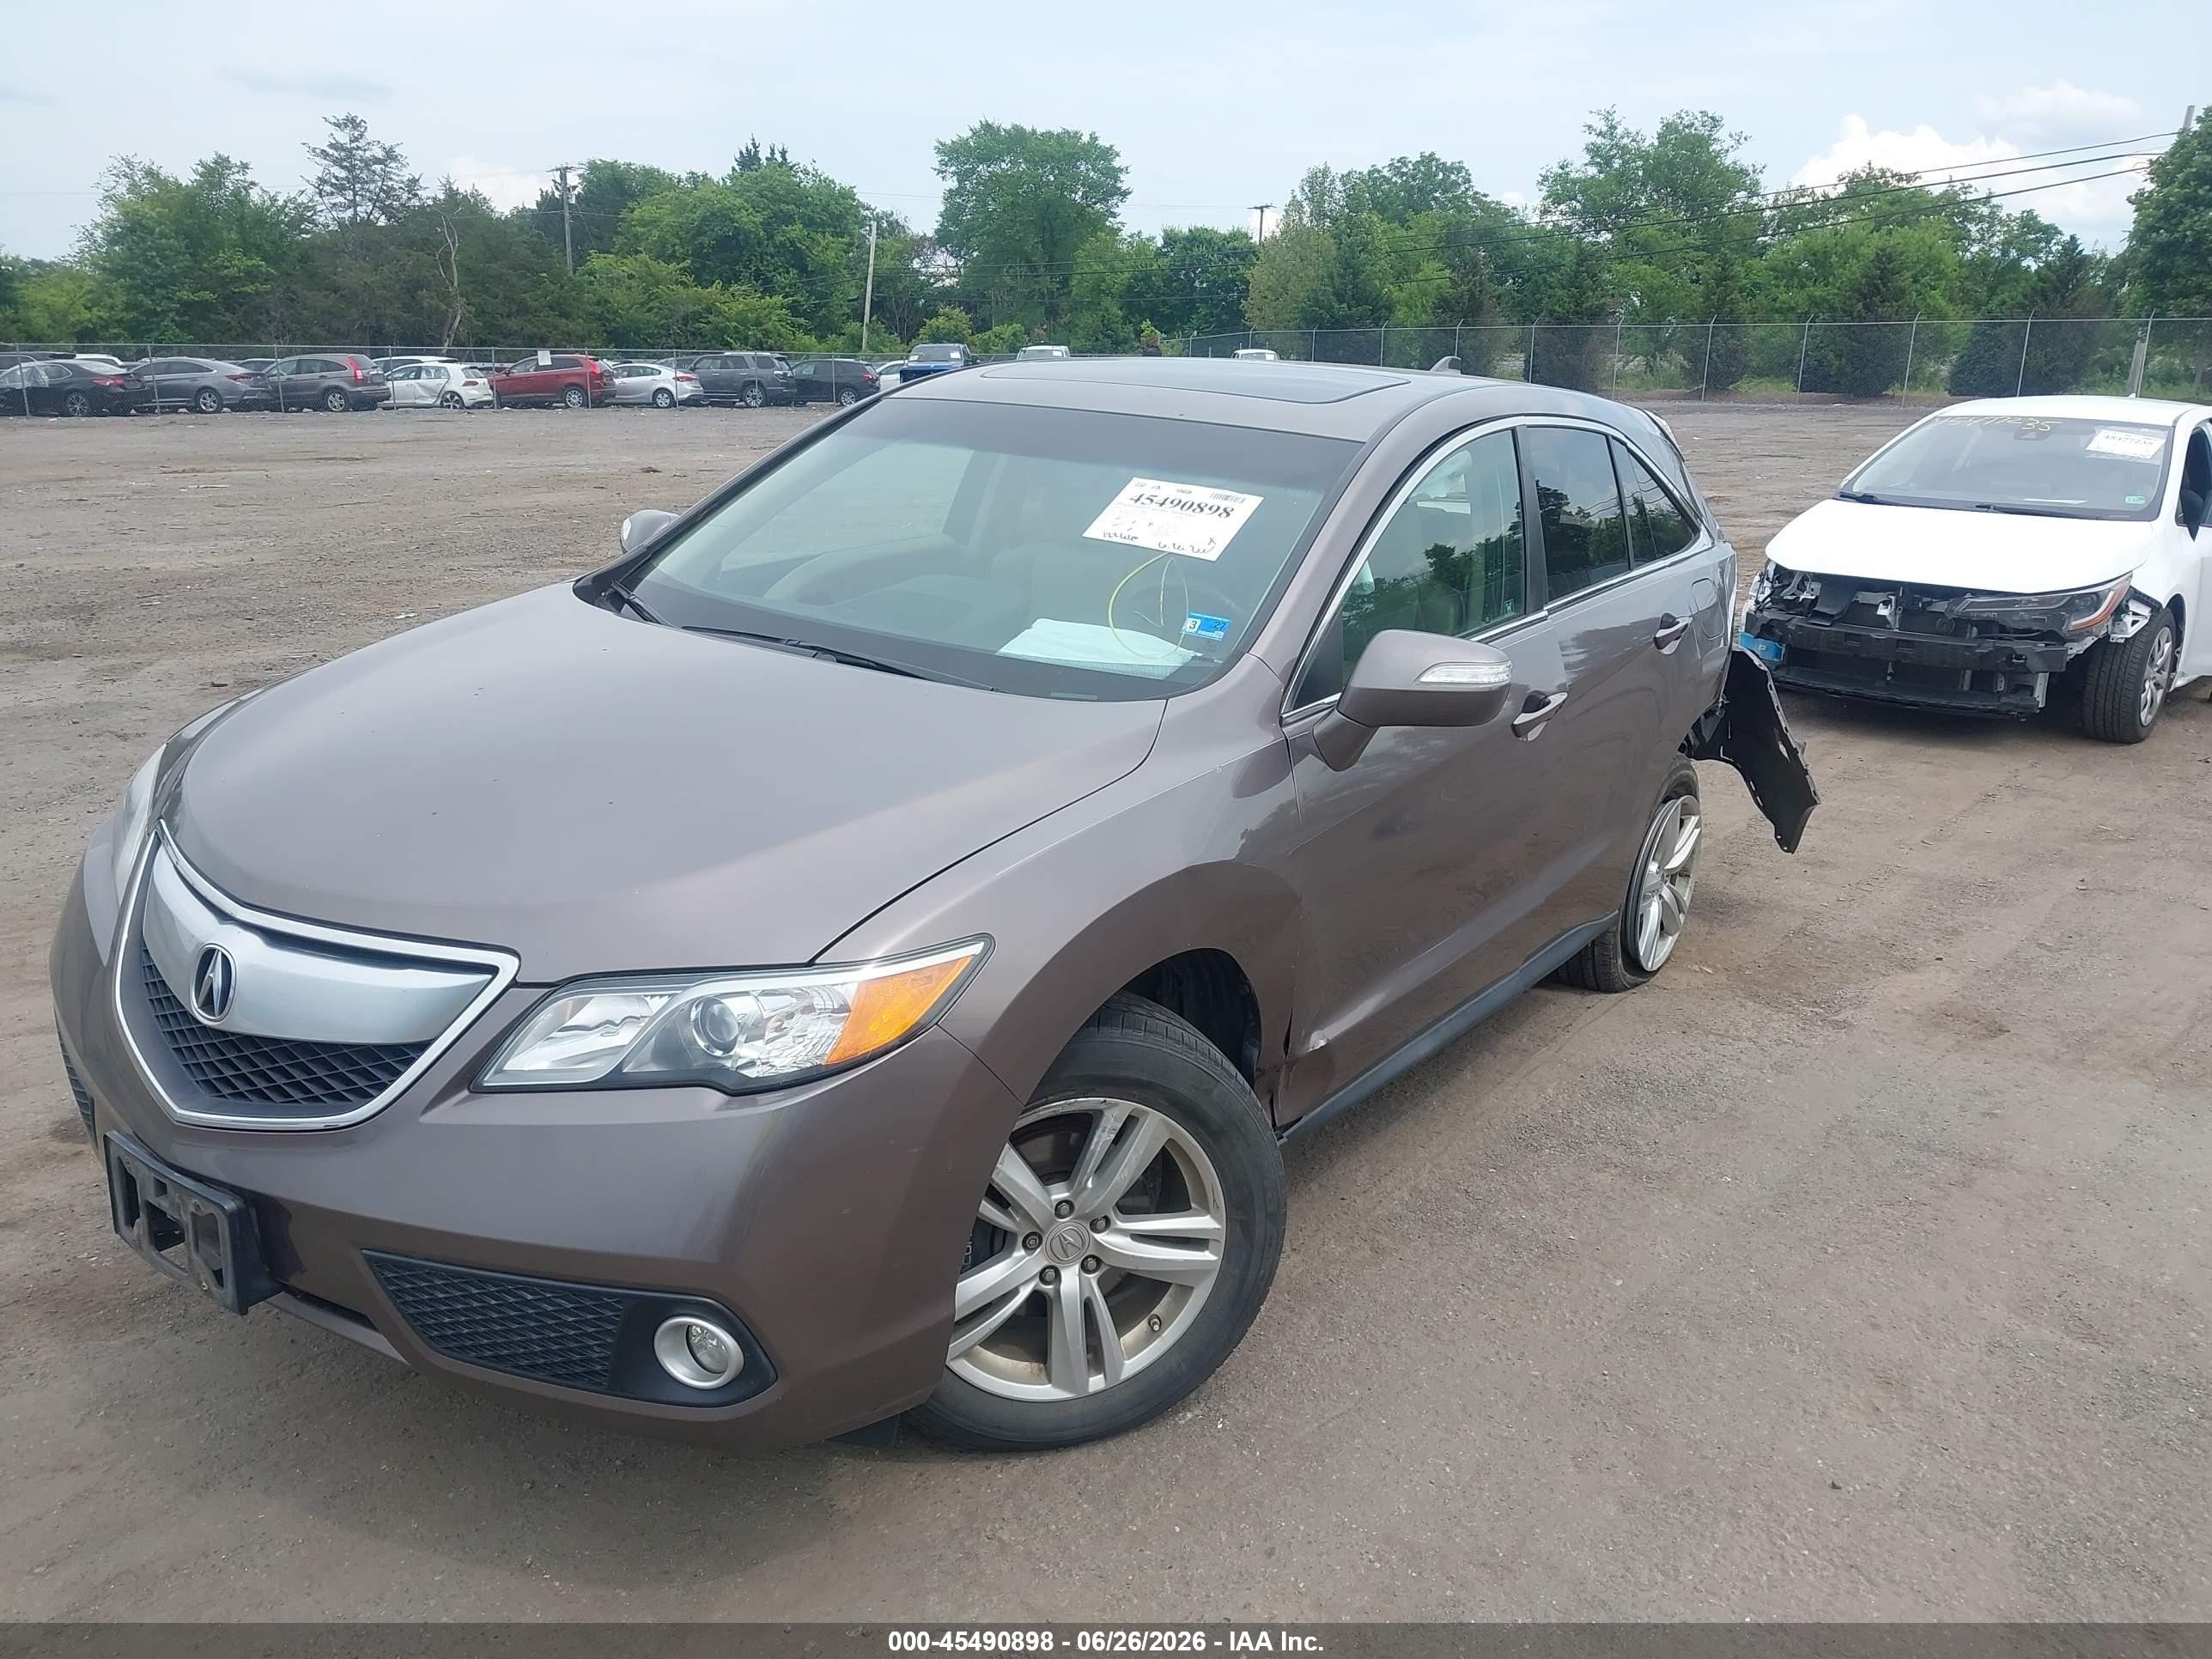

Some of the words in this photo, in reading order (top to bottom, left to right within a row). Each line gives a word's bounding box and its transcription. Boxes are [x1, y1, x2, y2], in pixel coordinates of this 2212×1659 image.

[1129, 493, 1235, 519] 45490898
[1188, 620, 1198, 629] 3
[1213, 620, 1227, 631] 27
